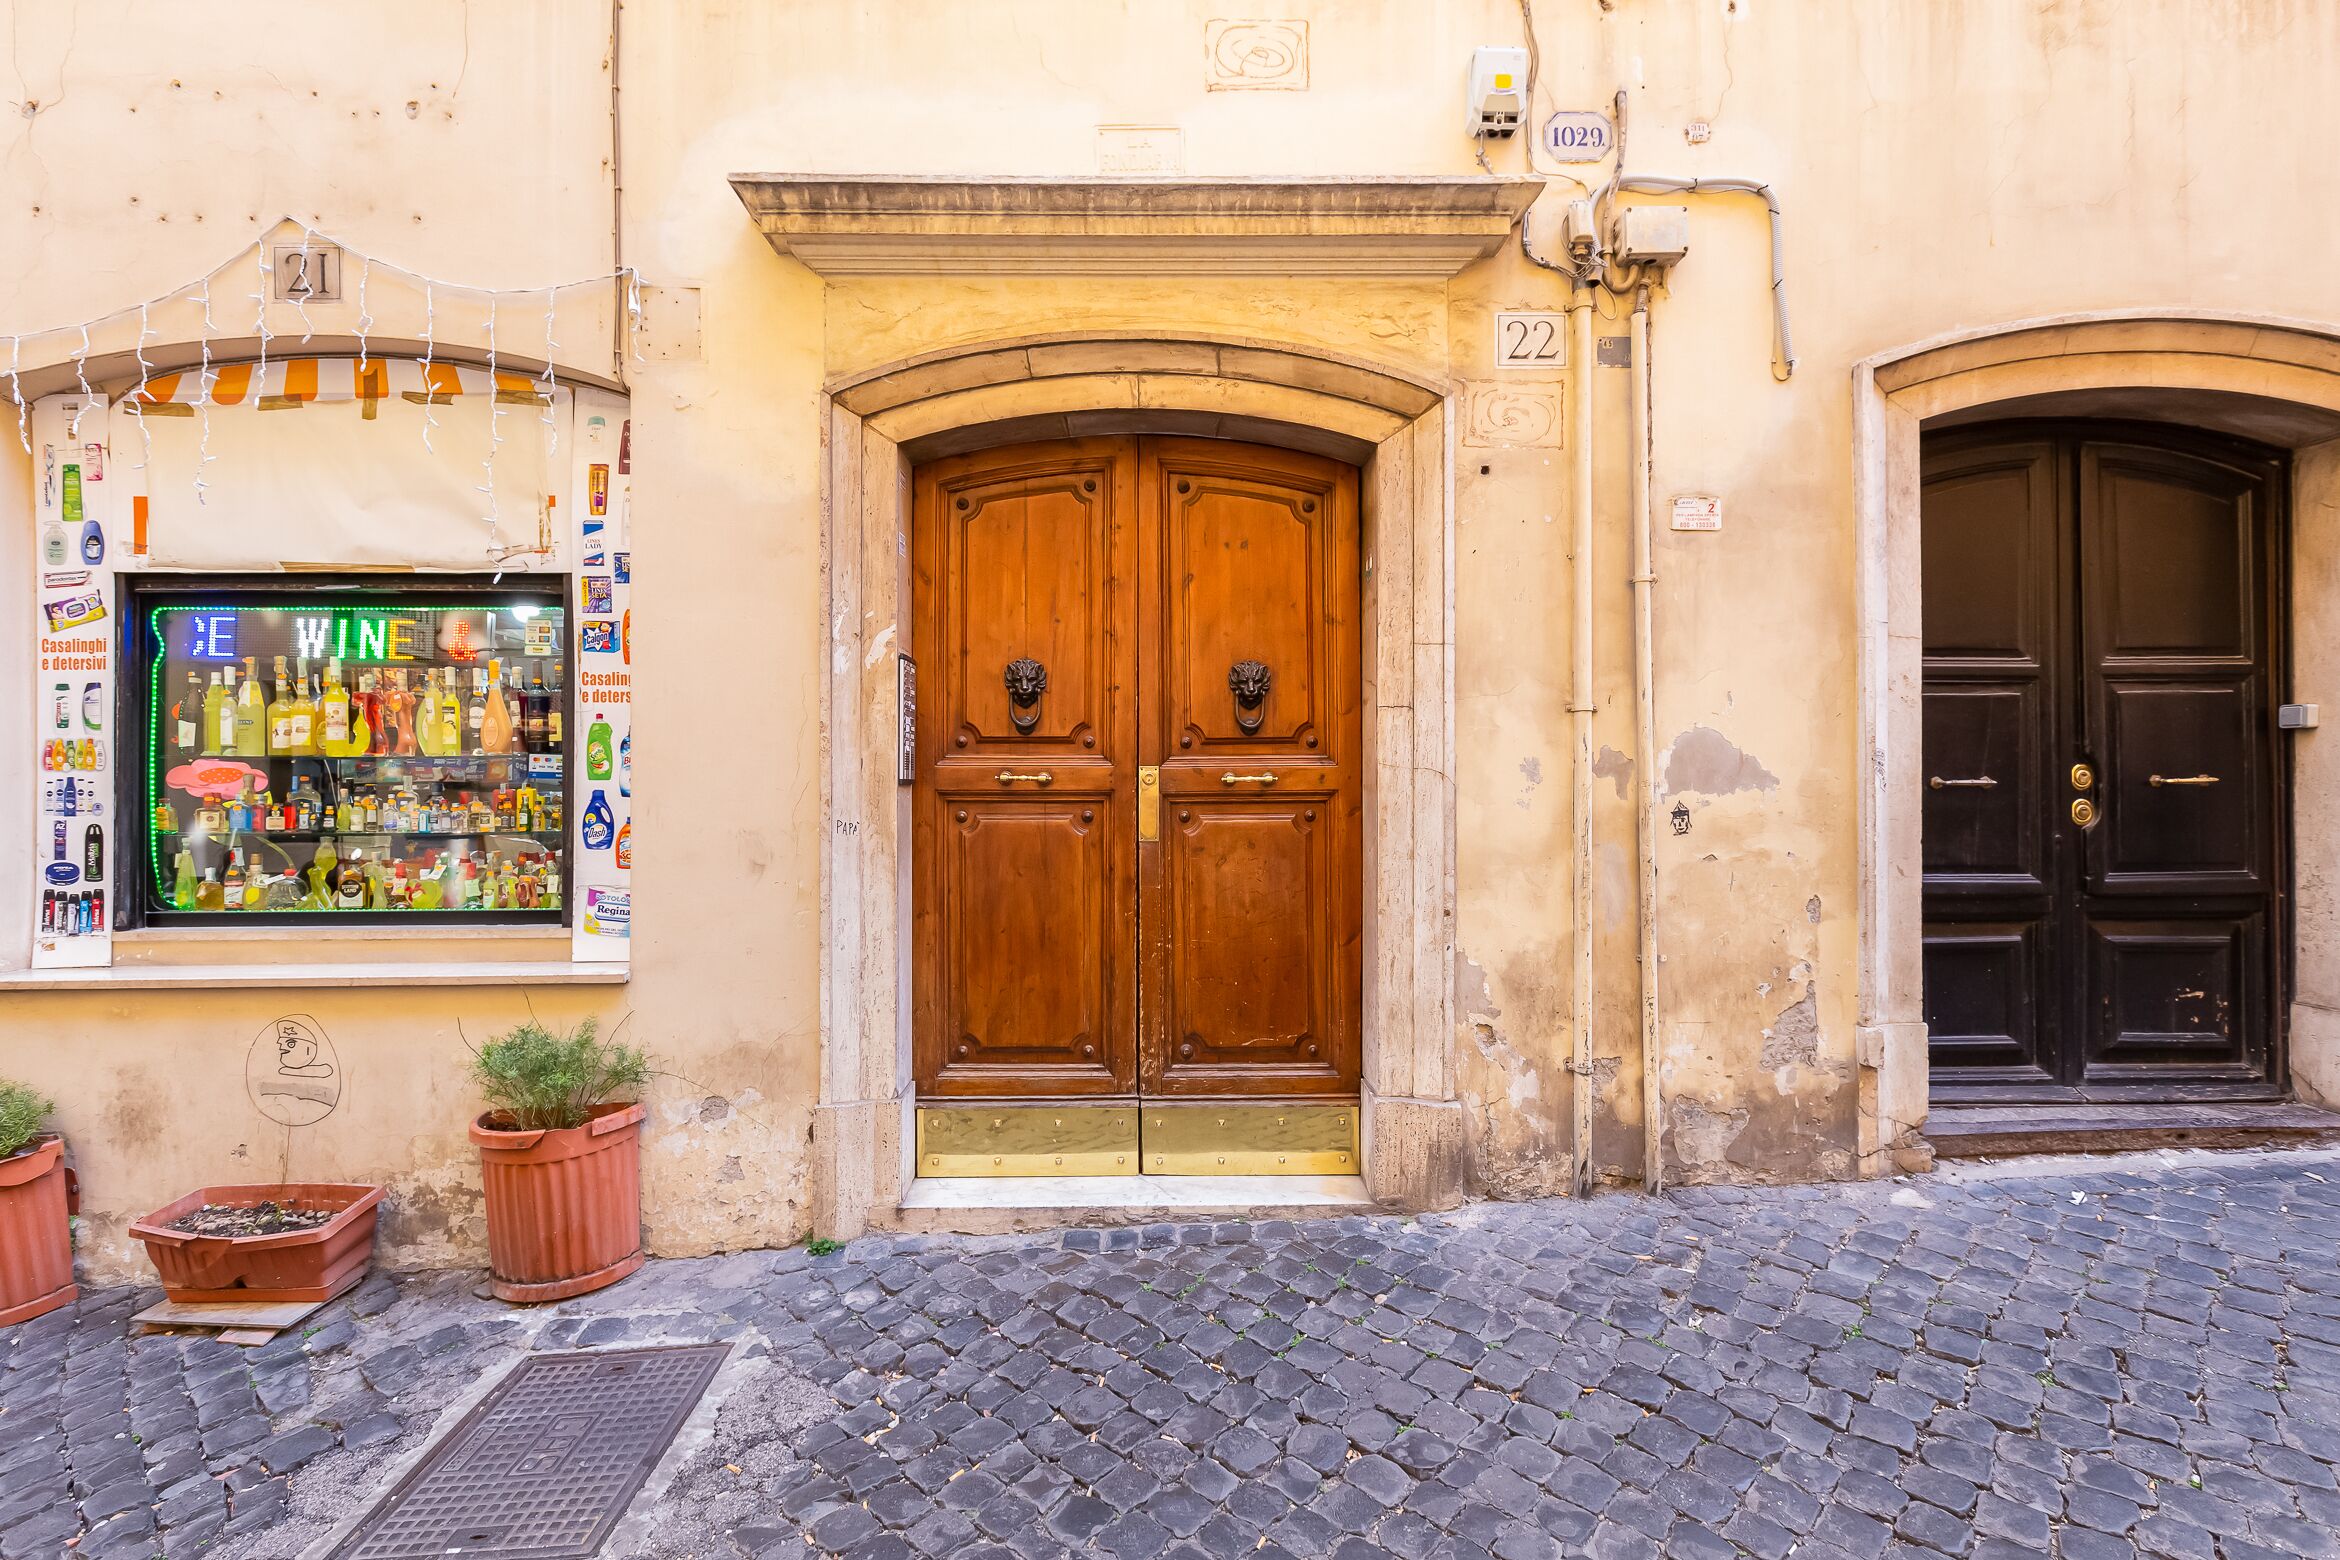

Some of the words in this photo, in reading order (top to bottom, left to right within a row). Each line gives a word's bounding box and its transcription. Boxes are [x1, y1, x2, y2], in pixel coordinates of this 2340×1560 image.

[285, 253, 330, 294] 21
[1507, 320, 1559, 361] 22
[1708, 503, 1715, 513] 2
[41, 638, 106, 654] Casalinghi
[296, 617, 416, 660] WINE
[586, 633, 608, 646] Calgon
[42, 658, 49, 671] e
[53, 656, 106, 671] detersivi
[581, 671, 630, 687] Casalin
[581, 691, 589, 703] e
[588, 826, 606, 839] Dash
[597, 904, 630, 917] Regina
